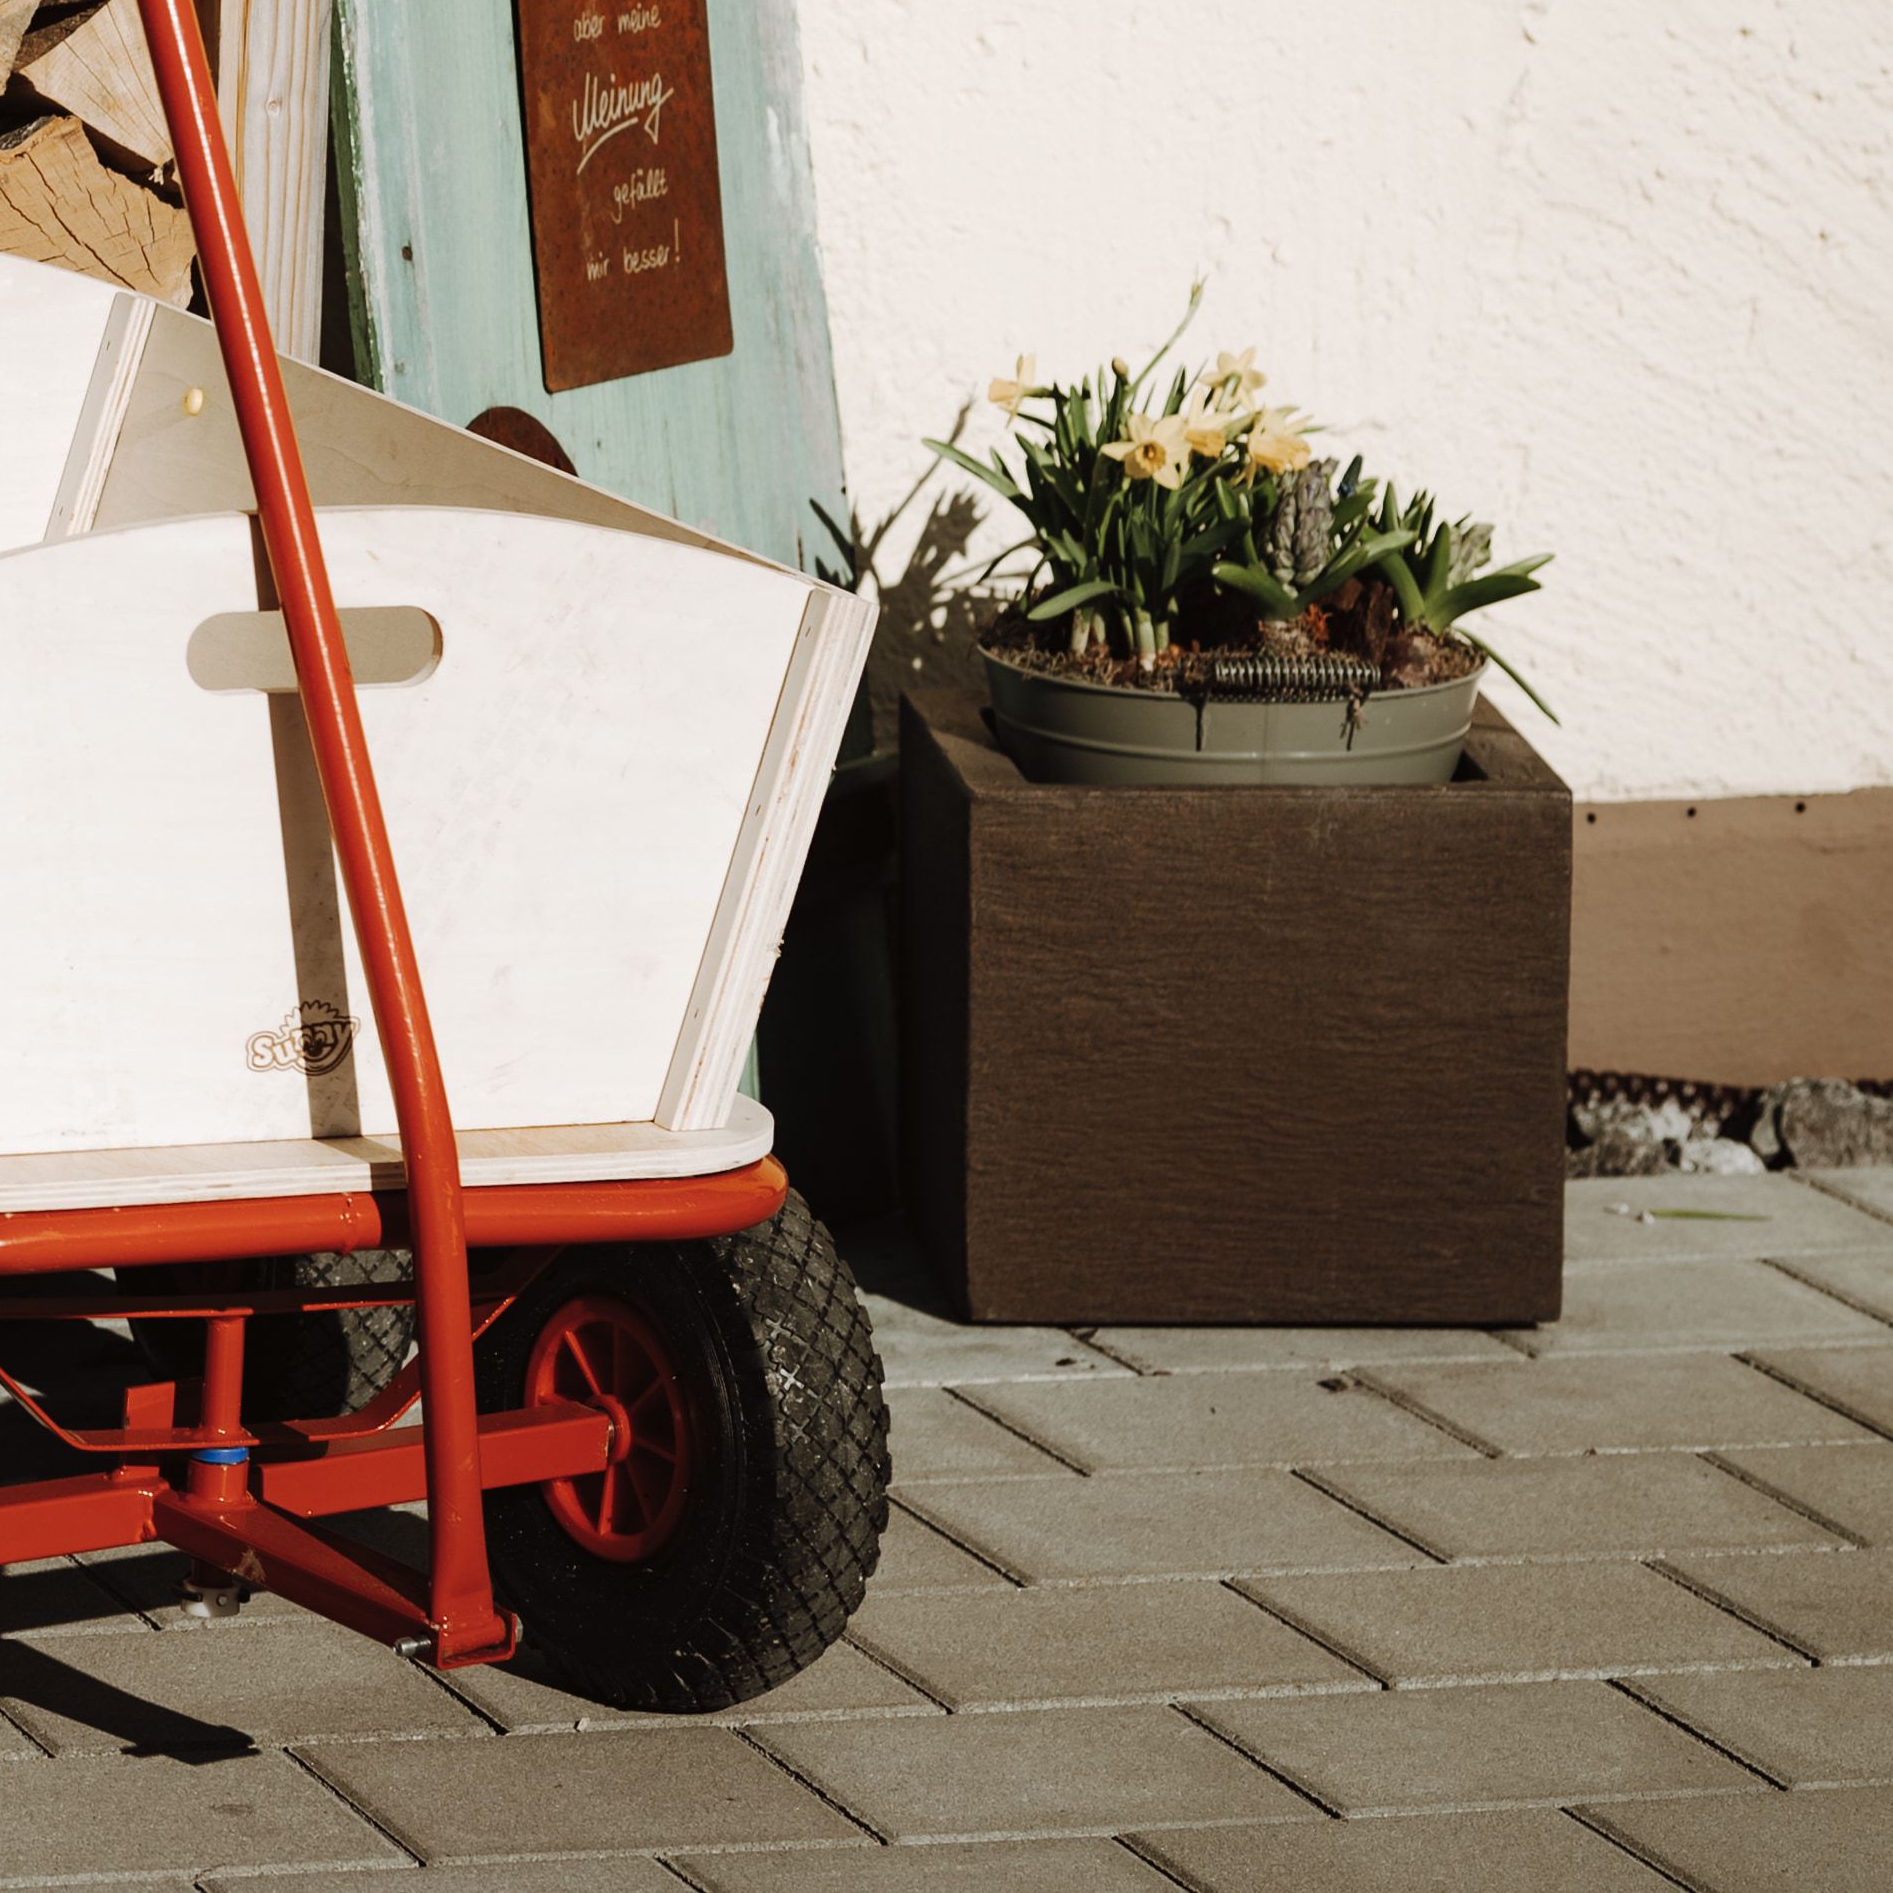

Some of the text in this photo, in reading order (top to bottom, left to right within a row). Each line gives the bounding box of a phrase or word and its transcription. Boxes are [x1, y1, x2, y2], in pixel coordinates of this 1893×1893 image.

[573, 2, 661, 42] aber meine
[573, 72, 674, 145] Meinung
[611, 168, 668, 224] gefällt
[586, 218, 680, 281] mir besser!
[249, 1018, 358, 1070] Sunny
